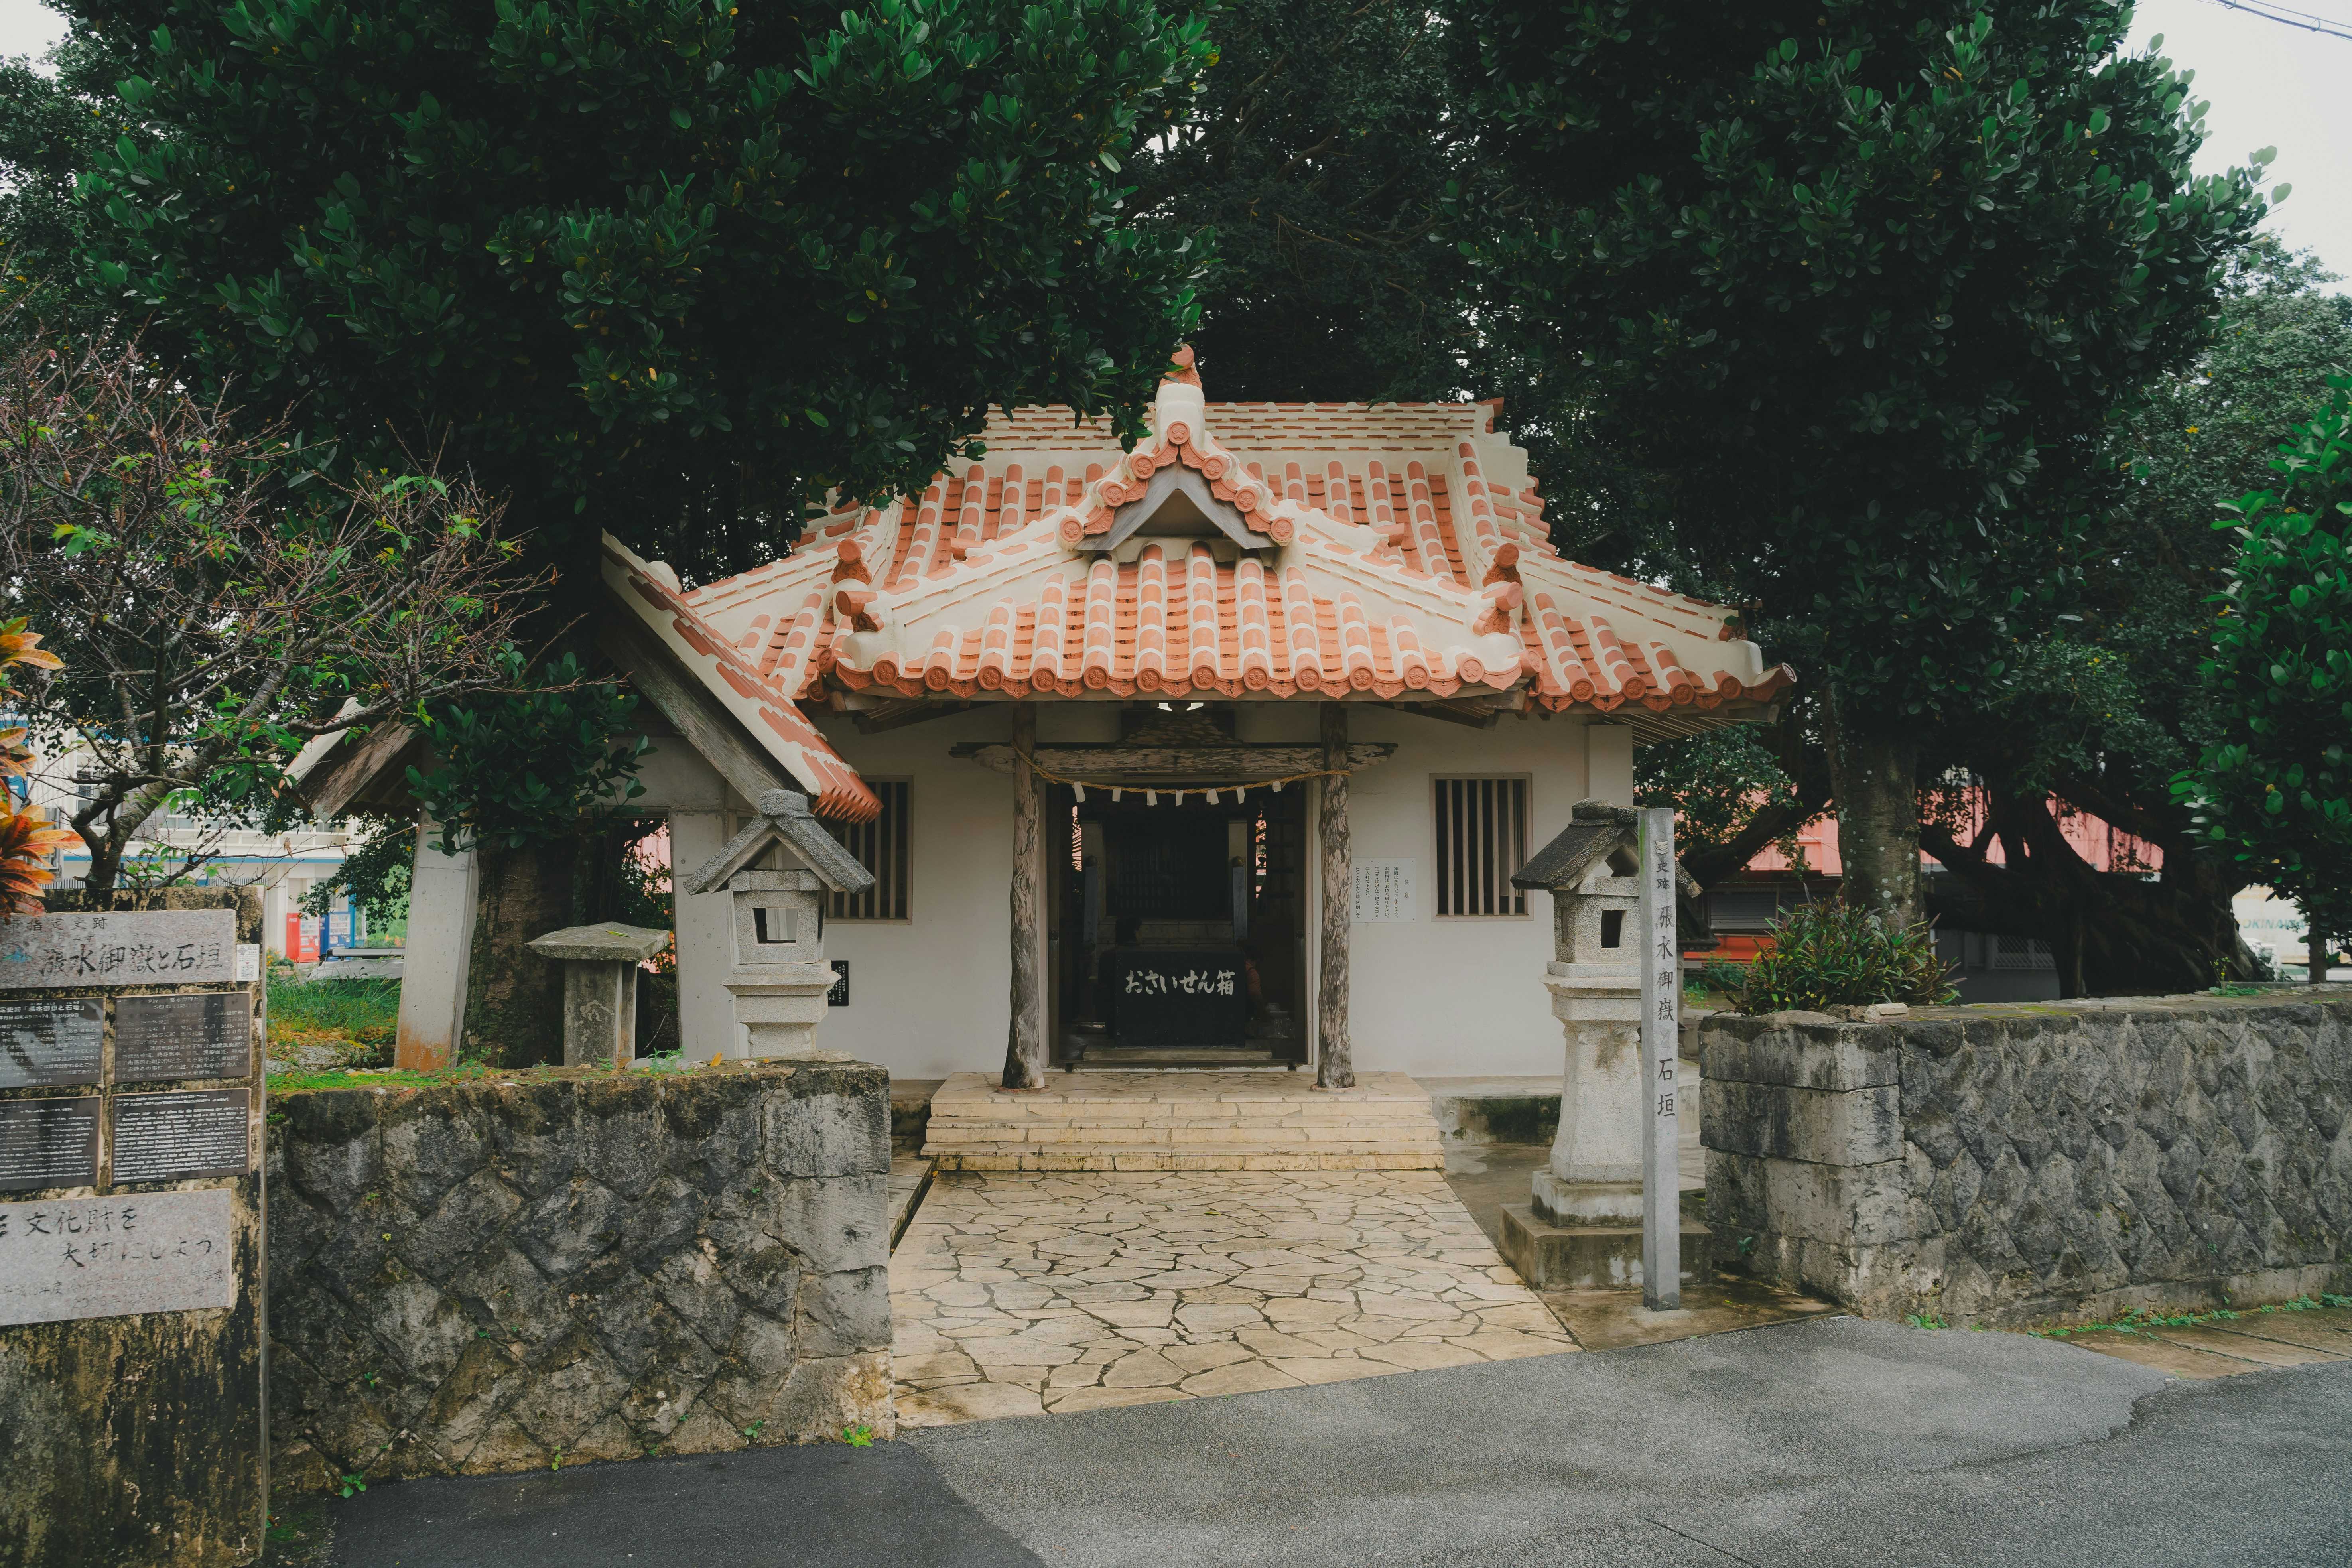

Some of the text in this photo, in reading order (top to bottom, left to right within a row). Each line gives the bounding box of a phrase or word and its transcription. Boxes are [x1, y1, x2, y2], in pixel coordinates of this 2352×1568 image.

[1125, 969, 1235, 995] おさいせん箱
